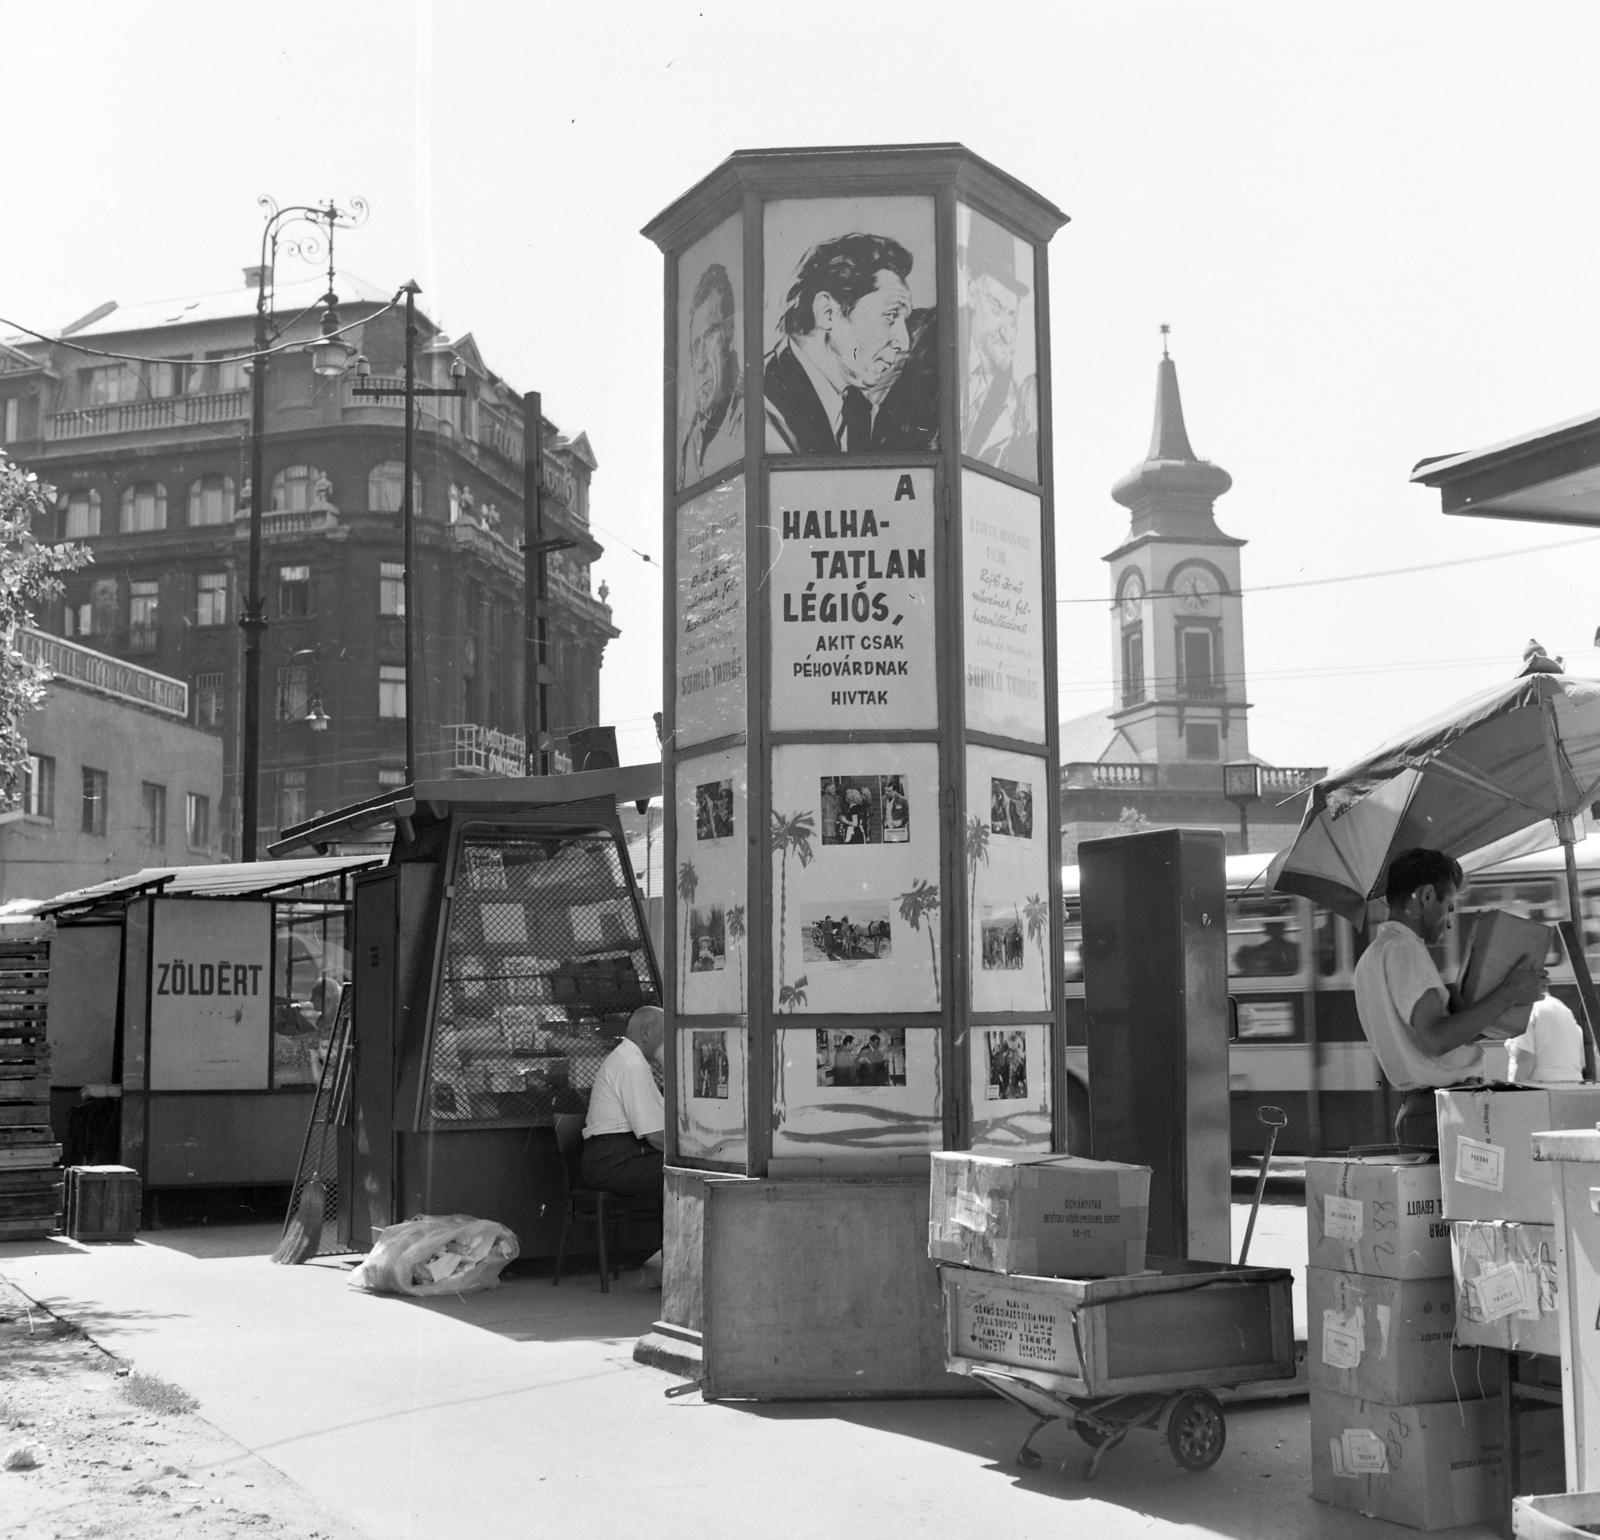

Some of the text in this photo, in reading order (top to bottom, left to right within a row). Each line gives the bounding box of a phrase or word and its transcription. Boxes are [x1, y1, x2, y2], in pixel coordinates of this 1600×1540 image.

[894, 474, 916, 502] A
[782, 509, 890, 540] HALHA-
[811, 549, 926, 579] TATLAN
[986, 546, 1006, 565] FILM
[783, 580, 904, 626] LÉGIÓS,
[815, 634, 904, 652] AKIT CSAK
[793, 654, 908, 678] PÉHOVÁRDNAK
[830, 690, 888, 706] HIVTAK
[156, 959, 263, 997] ZÖLDÉRT
[976, 1316, 1018, 1330] CIGARETTES
[981, 1327, 1052, 1346] DURRES FACTORY
